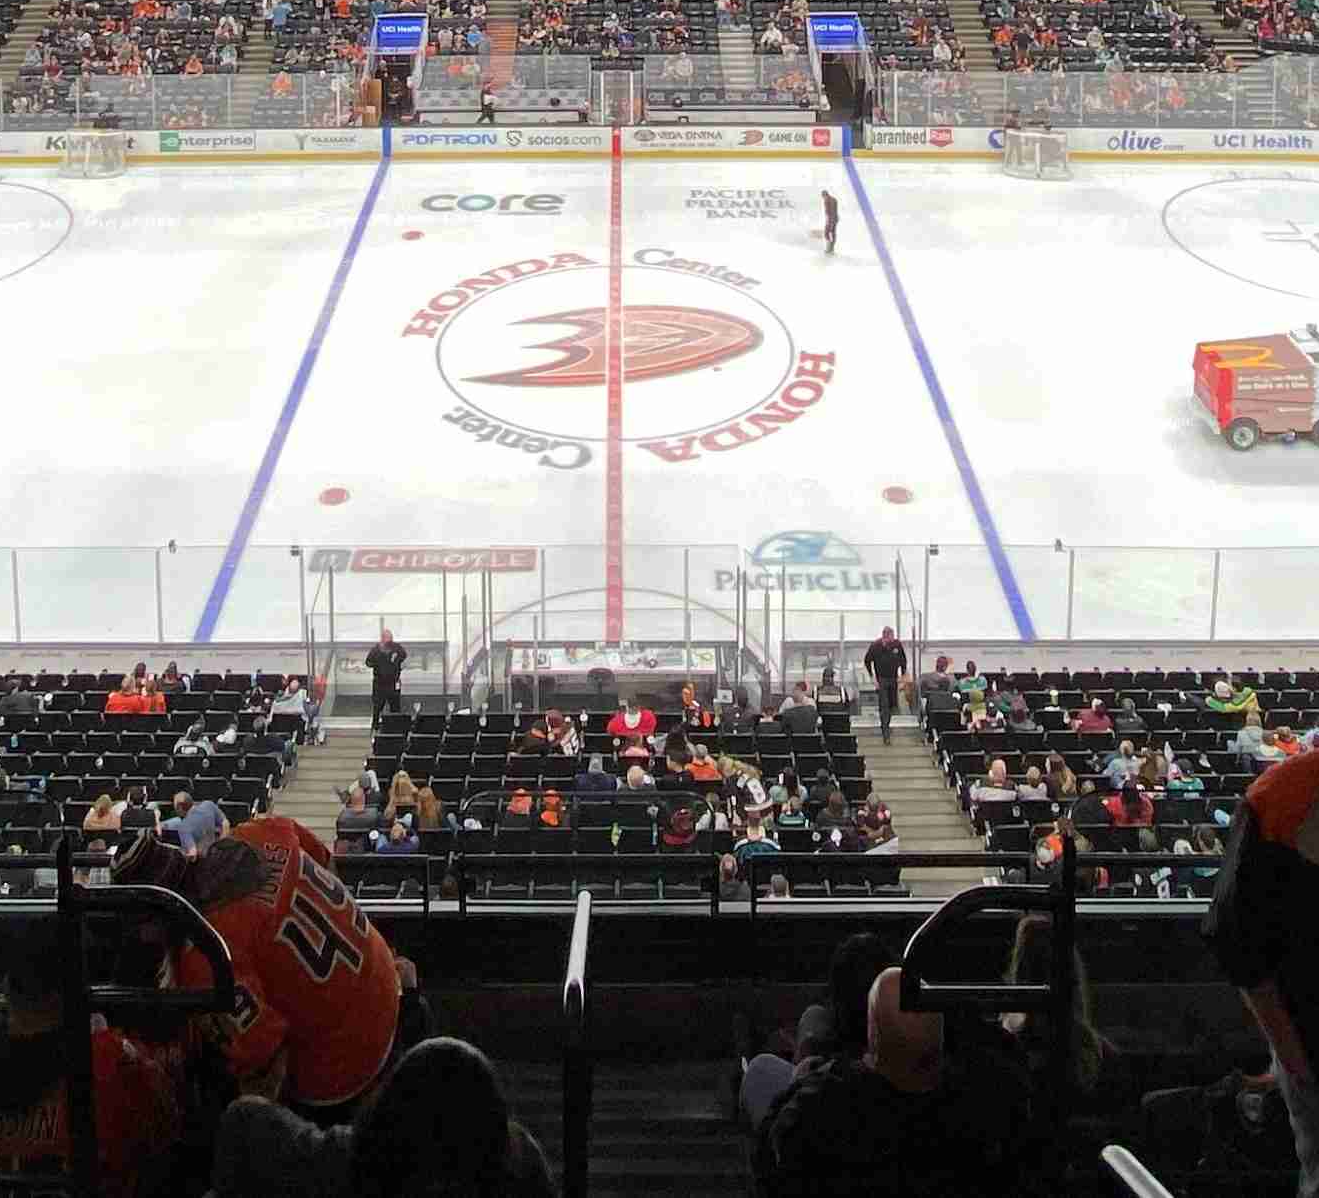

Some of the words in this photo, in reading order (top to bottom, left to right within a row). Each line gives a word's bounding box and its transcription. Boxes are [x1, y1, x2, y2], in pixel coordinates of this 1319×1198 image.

[382, 24, 396, 33] UCI
[397, 24, 422, 33] Health
[813, 24, 827, 32] UCI
[162, 136, 255, 149] enterprise
[402, 134, 499, 146] PDFTRON
[527, 133, 603, 146] socios.com
[1107, 130, 1163, 152] olive
[1213, 134, 1246, 149] UCI
[1253, 133, 1314, 151] Health
[689, 189, 786, 199] PACIFIC
[420, 193, 564, 213] core
[685, 199, 795, 210] PREMIER
[705, 209, 780, 220] BANK
[402, 251, 599, 339] HONDA
[633, 247, 763, 291] Center
[636, 349, 837, 464] HONDA
[441, 405, 593, 471] Center
[360, 552, 534, 569] CHIPOTLE
[713, 569, 838, 592] PACIFIC
